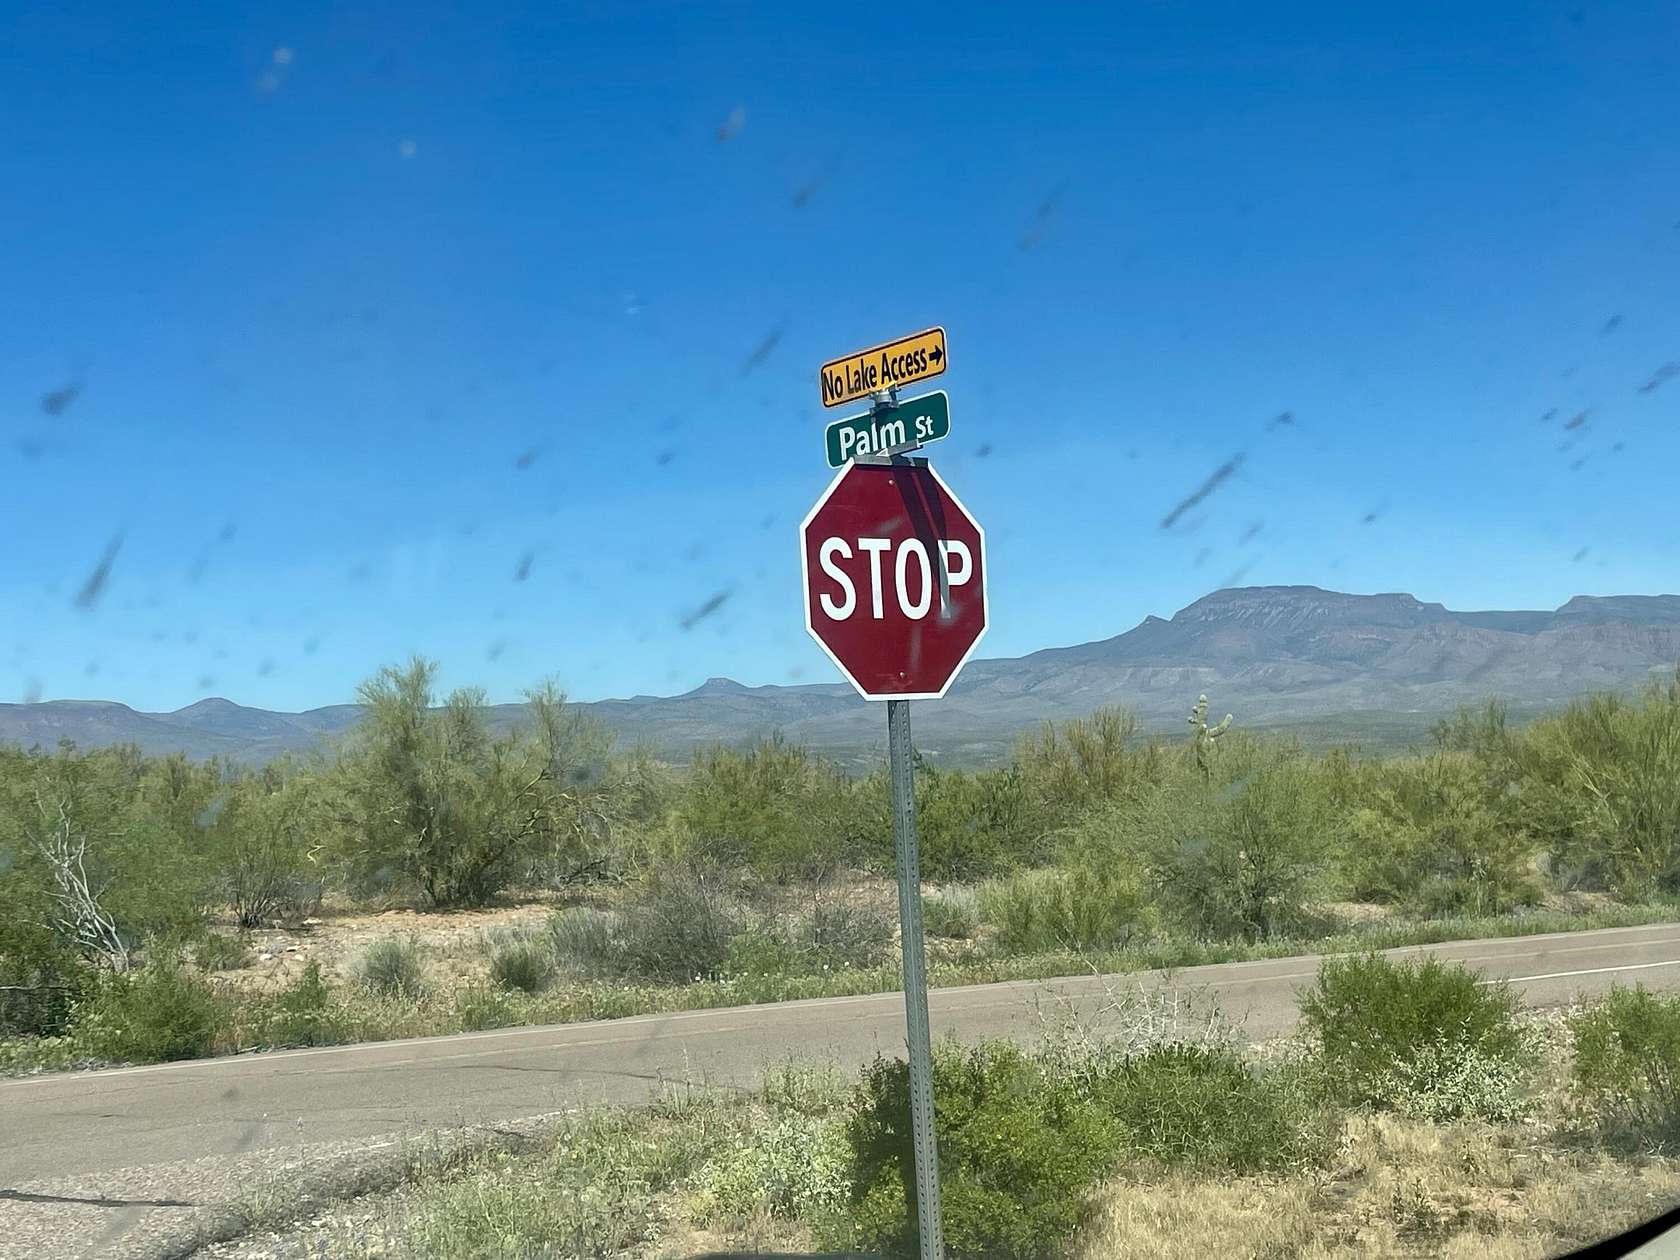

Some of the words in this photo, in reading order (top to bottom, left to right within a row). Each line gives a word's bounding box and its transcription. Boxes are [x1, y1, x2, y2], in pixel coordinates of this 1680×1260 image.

[823, 369, 843, 402] No
[846, 358, 877, 394] Lake
[881, 347, 926, 385] Access
[839, 419, 906, 461] Palm
[915, 415, 934, 439] St
[819, 536, 973, 621] STOP
